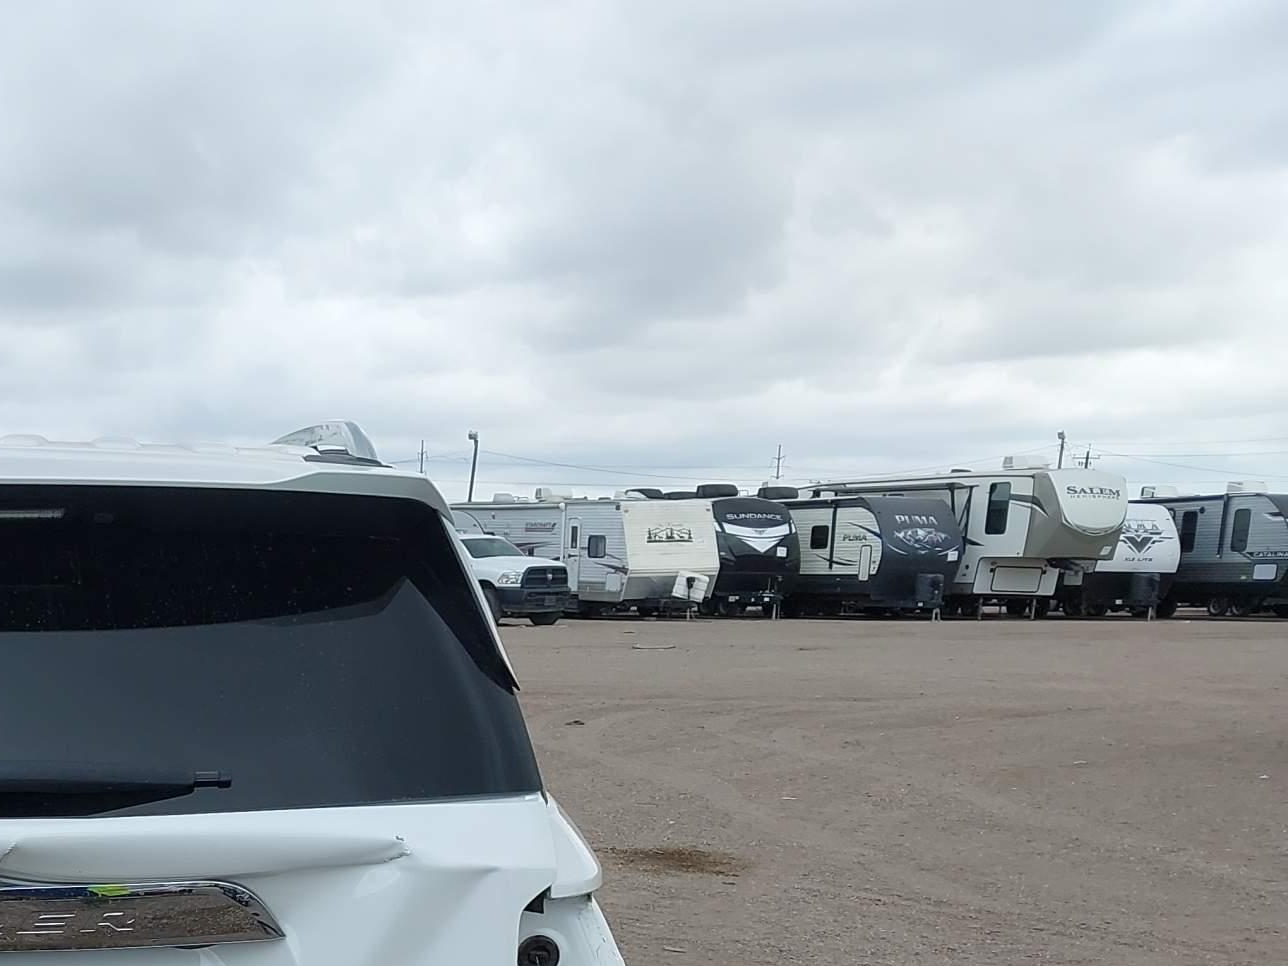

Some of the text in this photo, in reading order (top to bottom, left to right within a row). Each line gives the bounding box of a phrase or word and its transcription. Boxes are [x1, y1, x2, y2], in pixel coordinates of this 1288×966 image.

[1066, 485, 1121, 497] SALEM
[725, 512, 783, 521] SUNDANCE
[895, 515, 939, 525] PUMA
[842, 534, 868, 542] PUMA
